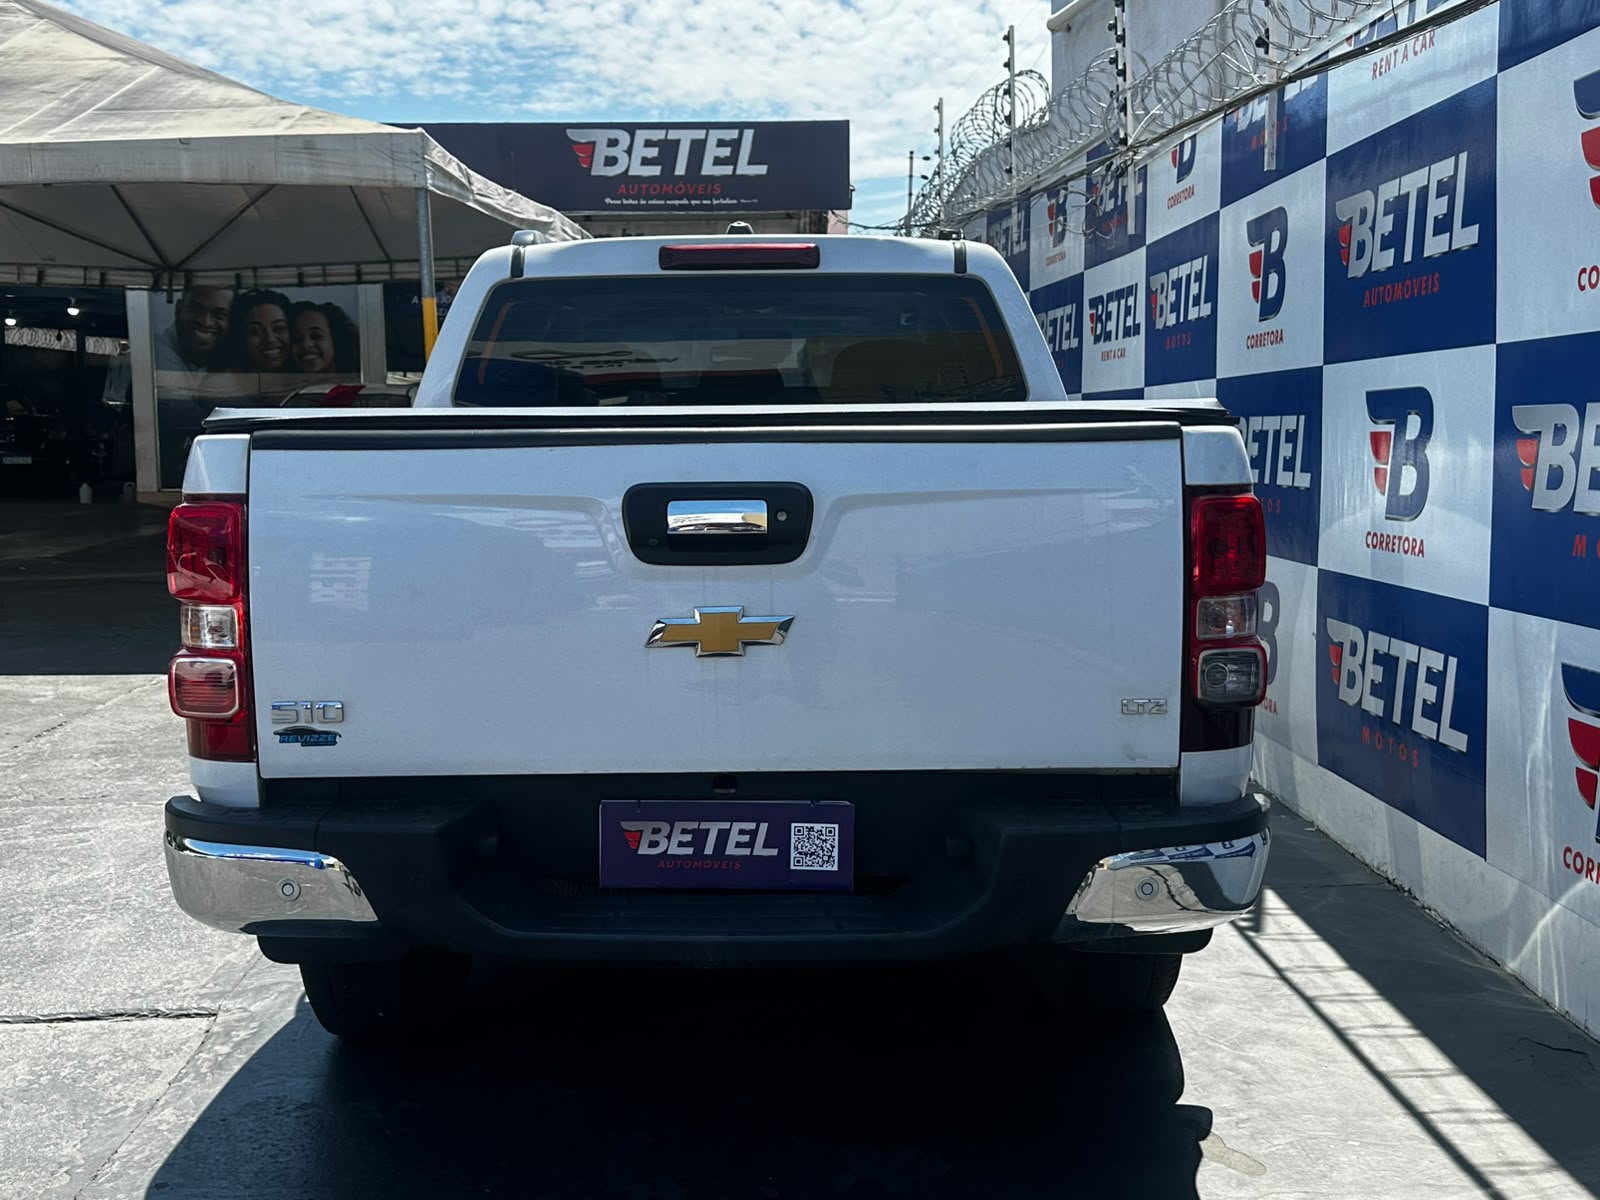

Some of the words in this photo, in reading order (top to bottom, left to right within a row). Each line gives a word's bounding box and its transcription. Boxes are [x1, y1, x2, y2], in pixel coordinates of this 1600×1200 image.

[1372, 48, 1398, 80] RENT
[1401, 50, 1409, 64] A
[1413, 31, 1435, 56] CAR
[566, 128, 768, 176] BETEL
[617, 182, 721, 195] AUTOMÓVEIS
[1335, 151, 1480, 279] BETEL
[1246, 206, 1288, 322] B
[1150, 255, 1212, 330] BETEL
[1363, 273, 1440, 307] AUTOMÓVEIS
[1088, 282, 1141, 345] BETEL
[1246, 329, 1284, 350] CORRETORA
[1366, 386, 1434, 522] B
[1365, 531, 1425, 558] CORRETORA
[1326, 617, 1469, 753] BETEL
[271, 701, 344, 724] S10
[1121, 698, 1168, 715] LTZ
[279, 733, 336, 744] REVIZZE
[1362, 726, 1419, 768] MOTOS
[620, 821, 779, 856] BETEL
